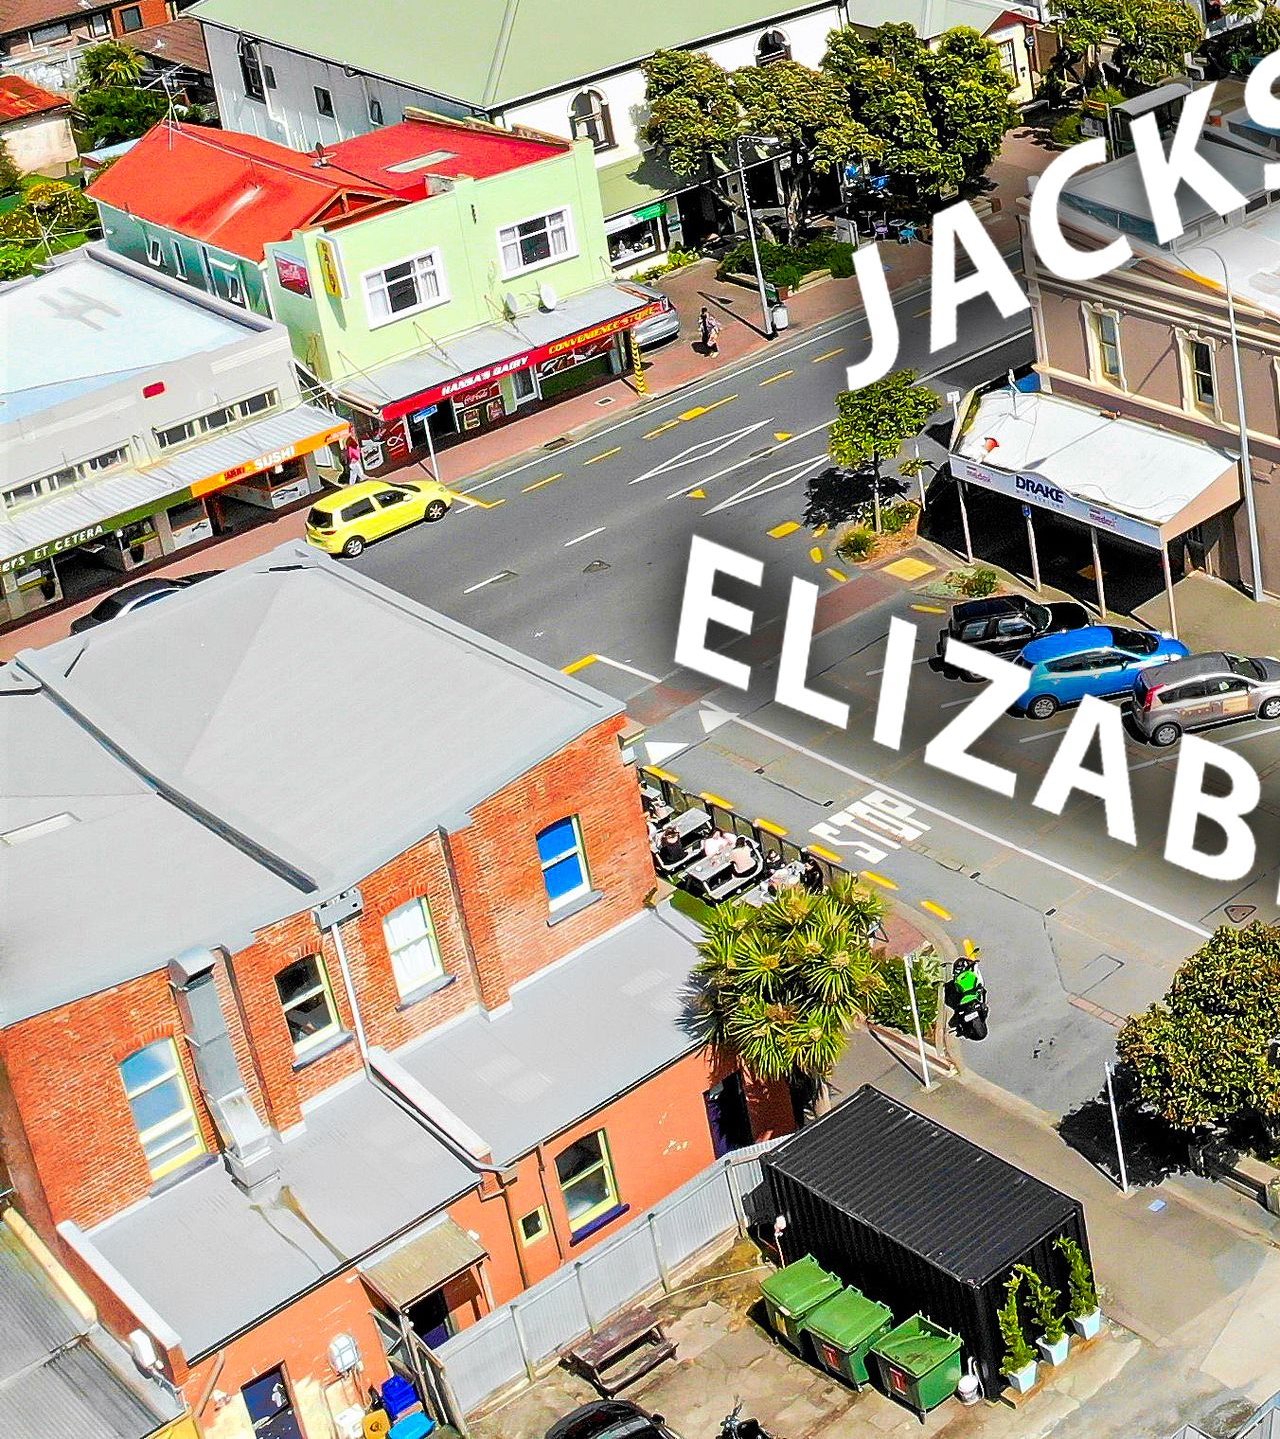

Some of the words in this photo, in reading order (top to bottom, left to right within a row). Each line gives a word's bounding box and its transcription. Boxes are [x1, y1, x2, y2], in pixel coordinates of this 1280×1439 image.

[493, 356, 529, 376] DAIRY
[548, 322, 621, 355] CONVENIENCE
[622, 306, 656, 326] STORE
[253, 446, 295, 470] SUSHI
[1015, 475, 1065, 504] DRAKE
[34, 545, 49, 559] ET
[54, 524, 104, 551] CETERA
[808, 789, 932, 865] STOP
